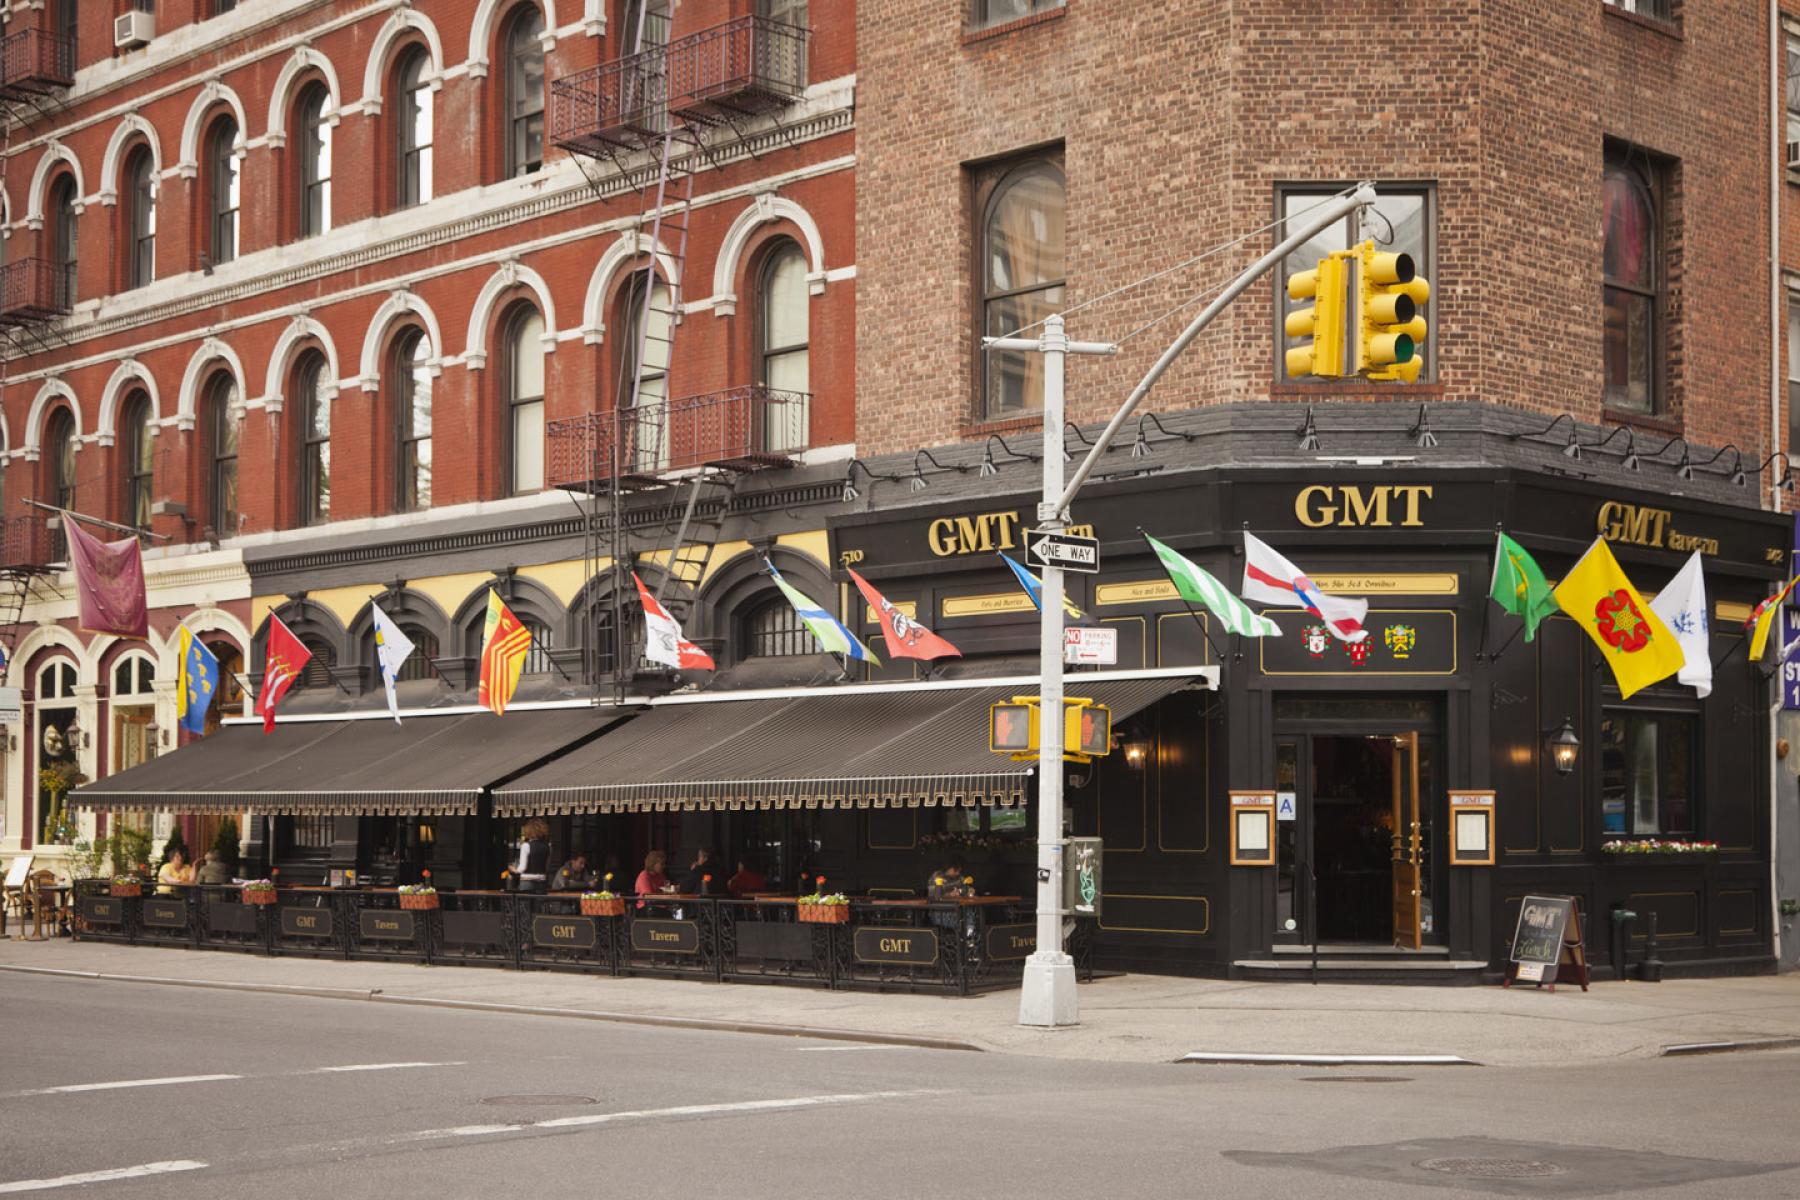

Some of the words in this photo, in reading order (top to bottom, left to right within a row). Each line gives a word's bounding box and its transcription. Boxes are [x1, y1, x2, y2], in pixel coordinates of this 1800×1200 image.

[1294, 485, 1433, 527] GMT
[1597, 501, 1671, 548] GMT
[928, 511, 1018, 557] GMT
[842, 549, 864, 568] 510
[1040, 543, 1061, 558] ONE
[1070, 547, 1091, 561] WAY
[1066, 630, 1080, 643] NO
[1280, 798, 1293, 813] A
[296, 916, 316, 928] GMT
[552, 925, 576, 938] GMT
[649, 929, 680, 942] Tavern
[879, 938, 912, 953] GMT
[1010, 936, 1036, 948] Tave
